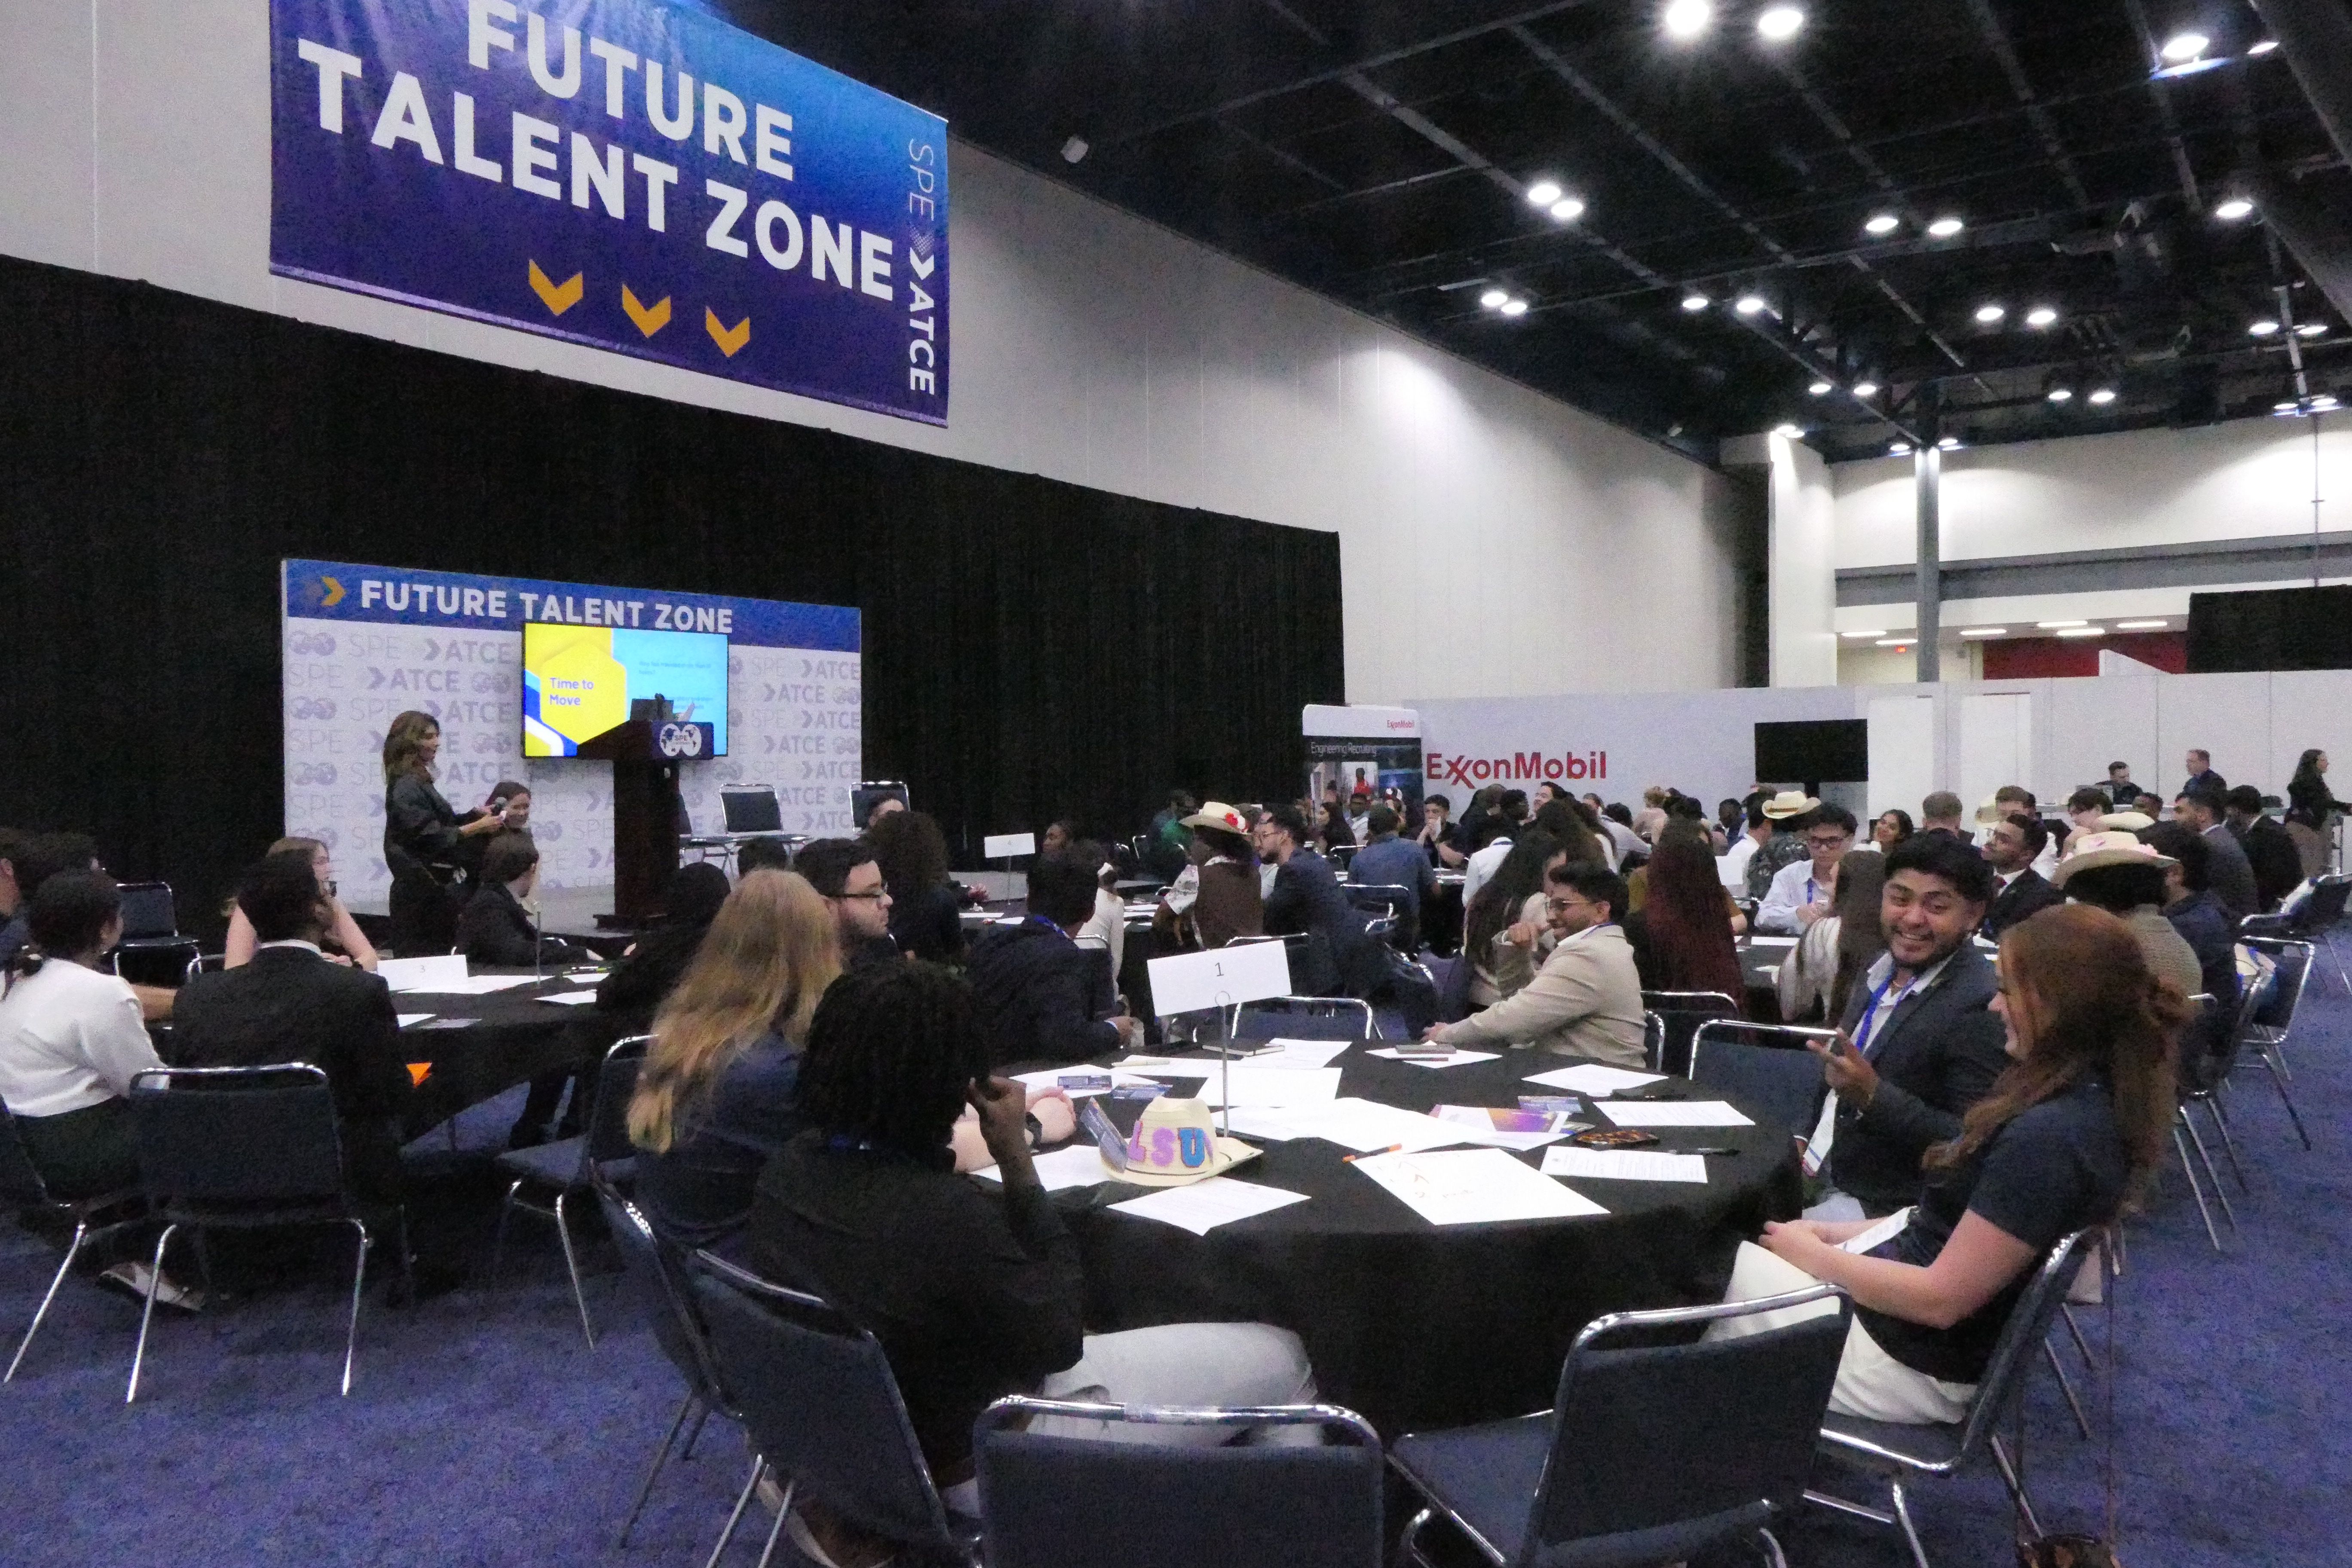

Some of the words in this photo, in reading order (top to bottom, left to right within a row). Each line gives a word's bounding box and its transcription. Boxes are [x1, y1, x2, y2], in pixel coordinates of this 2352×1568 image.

[468, 0, 794, 181] FUTURE
[297, 38, 678, 233] TALENT
[705, 178, 894, 302] ZONE
[909, 138, 934, 221] SPE
[909, 281, 935, 395] ATCE
[361, 579, 507, 618] FUTURE
[519, 592, 644, 627] TALENT
[655, 603, 732, 633] ZONE
[349, 634, 400, 659] SPE
[445, 639, 513, 664] ATCE
[287, 663, 344, 689] SPE
[390, 668, 460, 692] ATCE
[815, 660, 861, 681] ATCE
[550, 677, 579, 689] Time
[582, 680, 594, 689] to
[778, 683, 825, 704] ATCE
[550, 694, 580, 705] Move
[444, 700, 513, 723] ATCE
[815, 710, 861, 729] ATCE
[1387, 720, 1415, 730] ExxonMobil
[778, 735, 826, 755] ATCE
[1311, 742, 1347, 756] Engineering
[445, 762, 511, 785] ATCE
[815, 761, 861, 779] ATCE
[1426, 750, 1607, 789] ExxonMobil
[779, 787, 826, 805] ATCE
[816, 811, 850, 830] ATC
[420, 965, 426, 973] 3
[1214, 962, 1225, 977] 1
[1127, 1119, 1206, 1168] LSU
